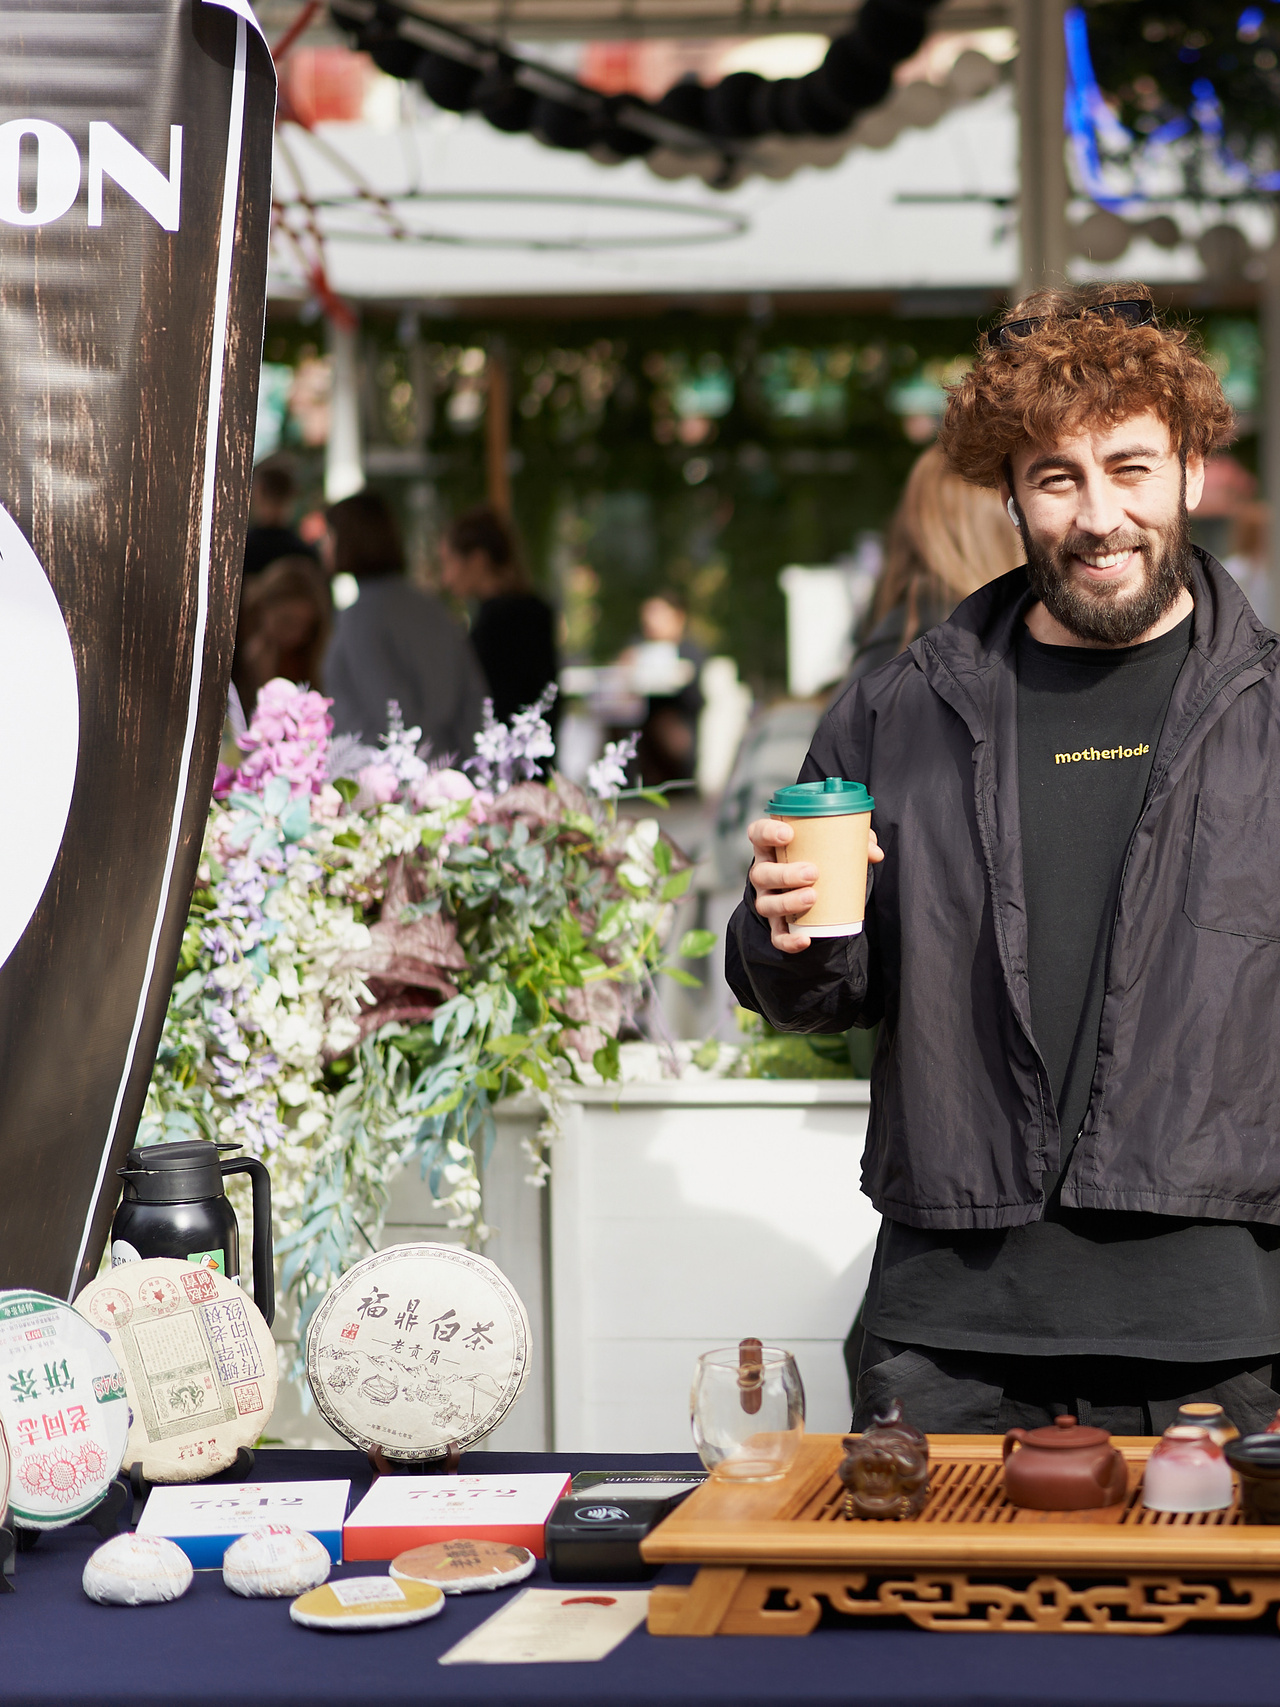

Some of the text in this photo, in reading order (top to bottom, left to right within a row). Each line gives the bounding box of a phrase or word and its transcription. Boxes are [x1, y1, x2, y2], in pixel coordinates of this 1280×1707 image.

[1055, 742, 1150, 765] motherlode
[357, 1286, 494, 1351] 福鼎白茶
[390, 1338, 441, 1366] 老贡眉
[8, 1359, 76, 1403] 饼茶
[17, 1404, 92, 1446] 老同志
[408, 1489, 518, 1500] 7572
